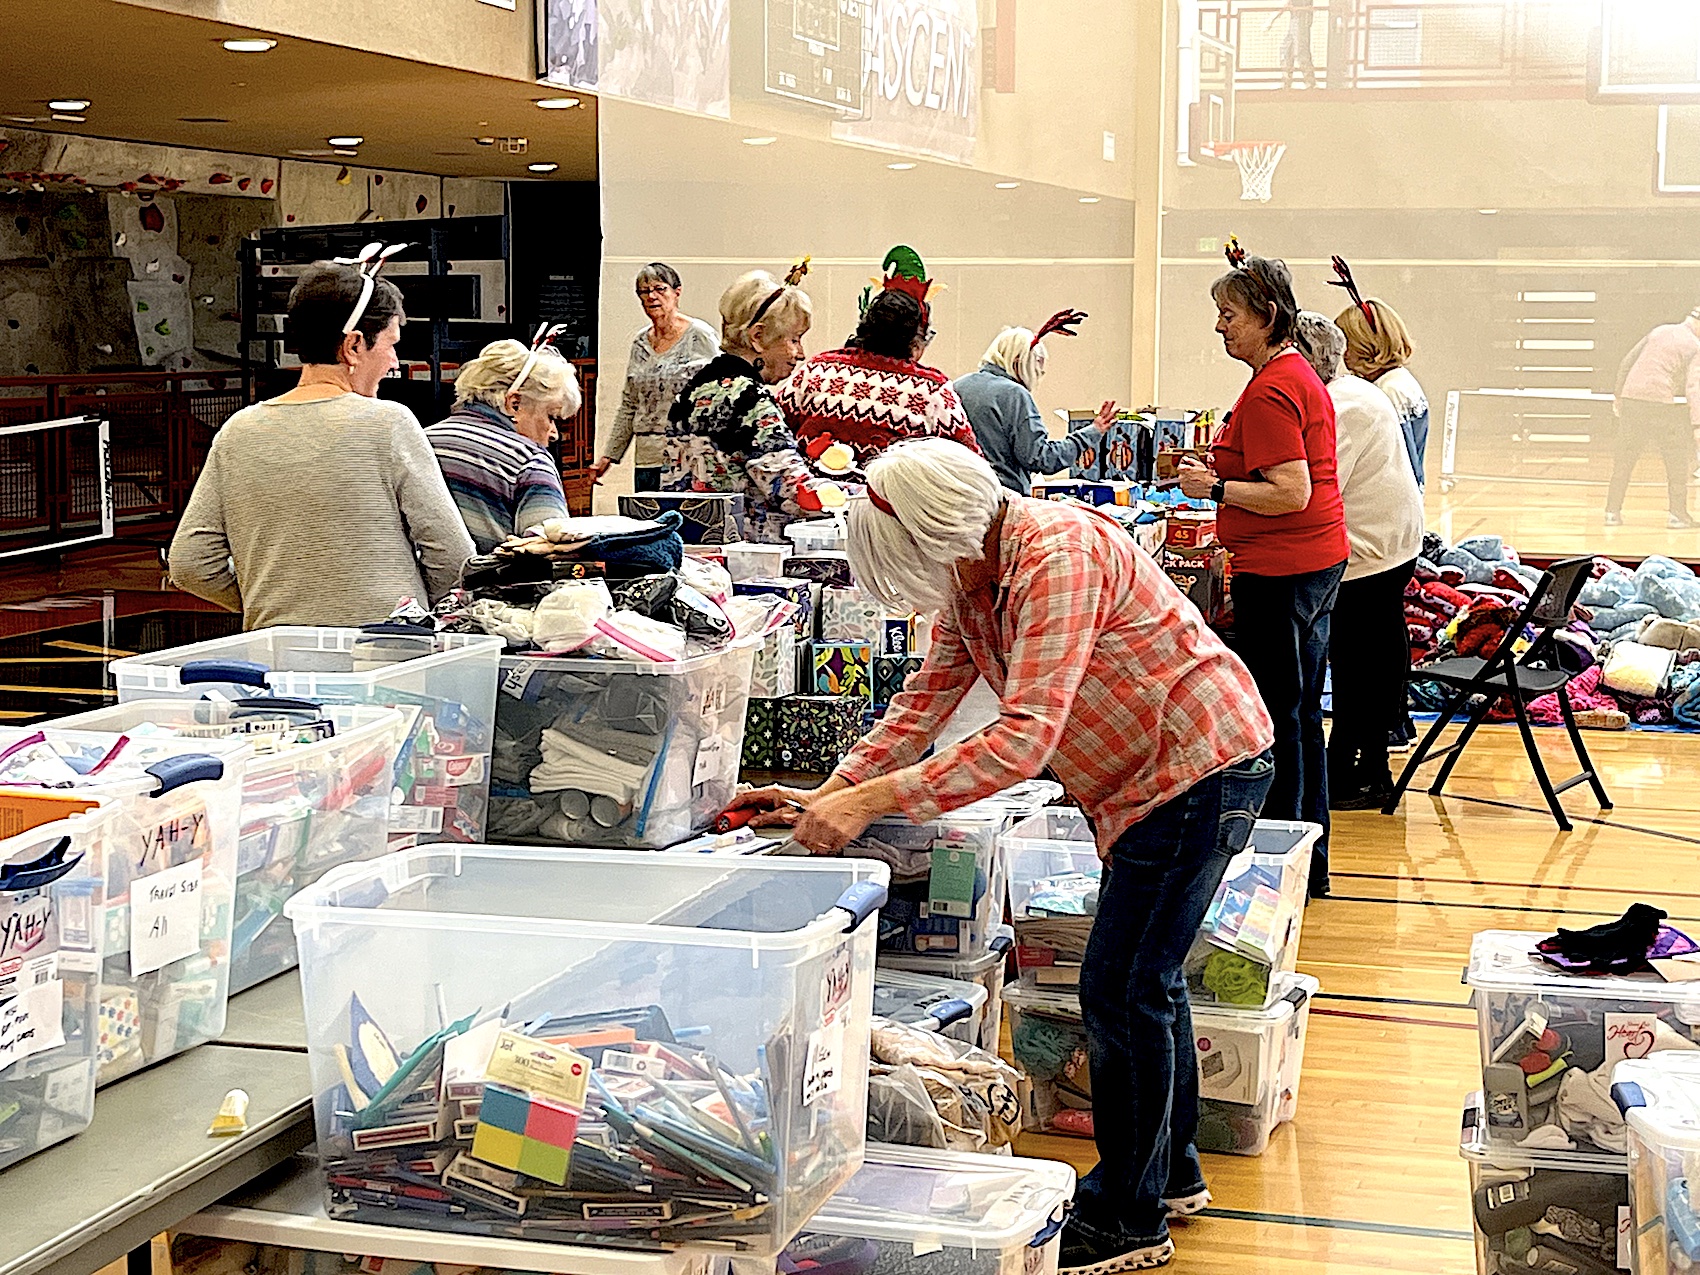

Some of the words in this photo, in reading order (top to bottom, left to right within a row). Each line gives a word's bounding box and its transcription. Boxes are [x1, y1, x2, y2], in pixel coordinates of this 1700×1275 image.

[862, 0, 975, 118] ASCENT
[1174, 530, 1189, 539] 45
[1178, 560, 1205, 568] PACK
